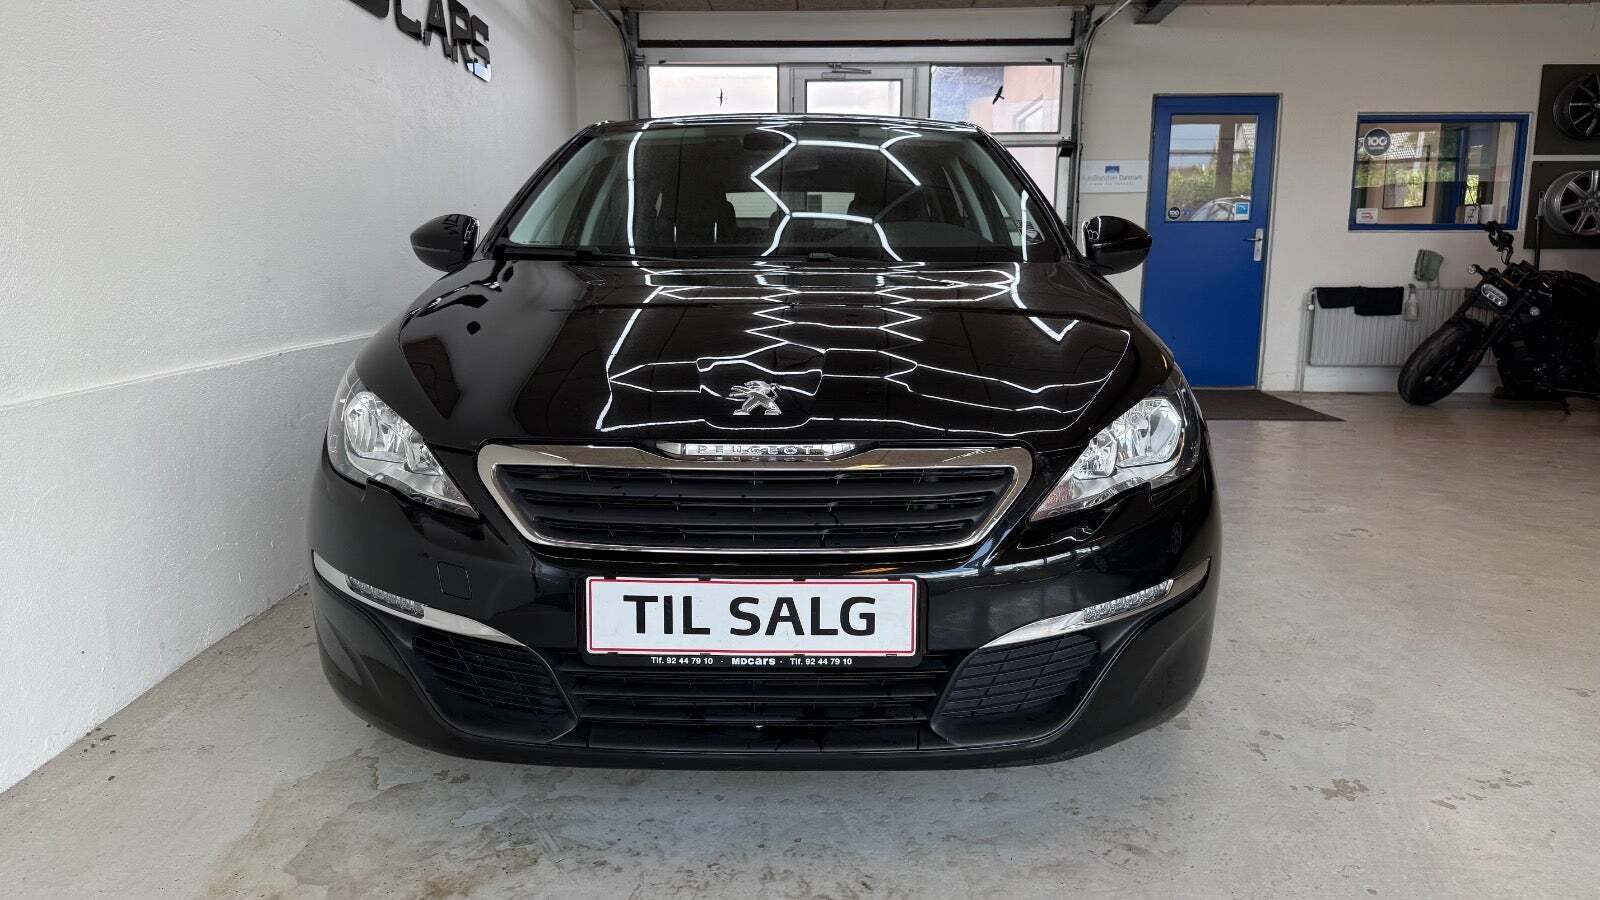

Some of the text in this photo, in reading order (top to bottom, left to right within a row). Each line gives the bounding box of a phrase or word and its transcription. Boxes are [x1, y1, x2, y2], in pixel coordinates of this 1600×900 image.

[393, 0, 492, 83] CARS
[698, 445, 813, 456] PEUGEOT
[623, 595, 876, 637] TIL SALG
[678, 657, 689, 665] 44
[691, 657, 702, 665] 79
[703, 657, 714, 665] 10
[731, 657, 776, 666] MDcars
